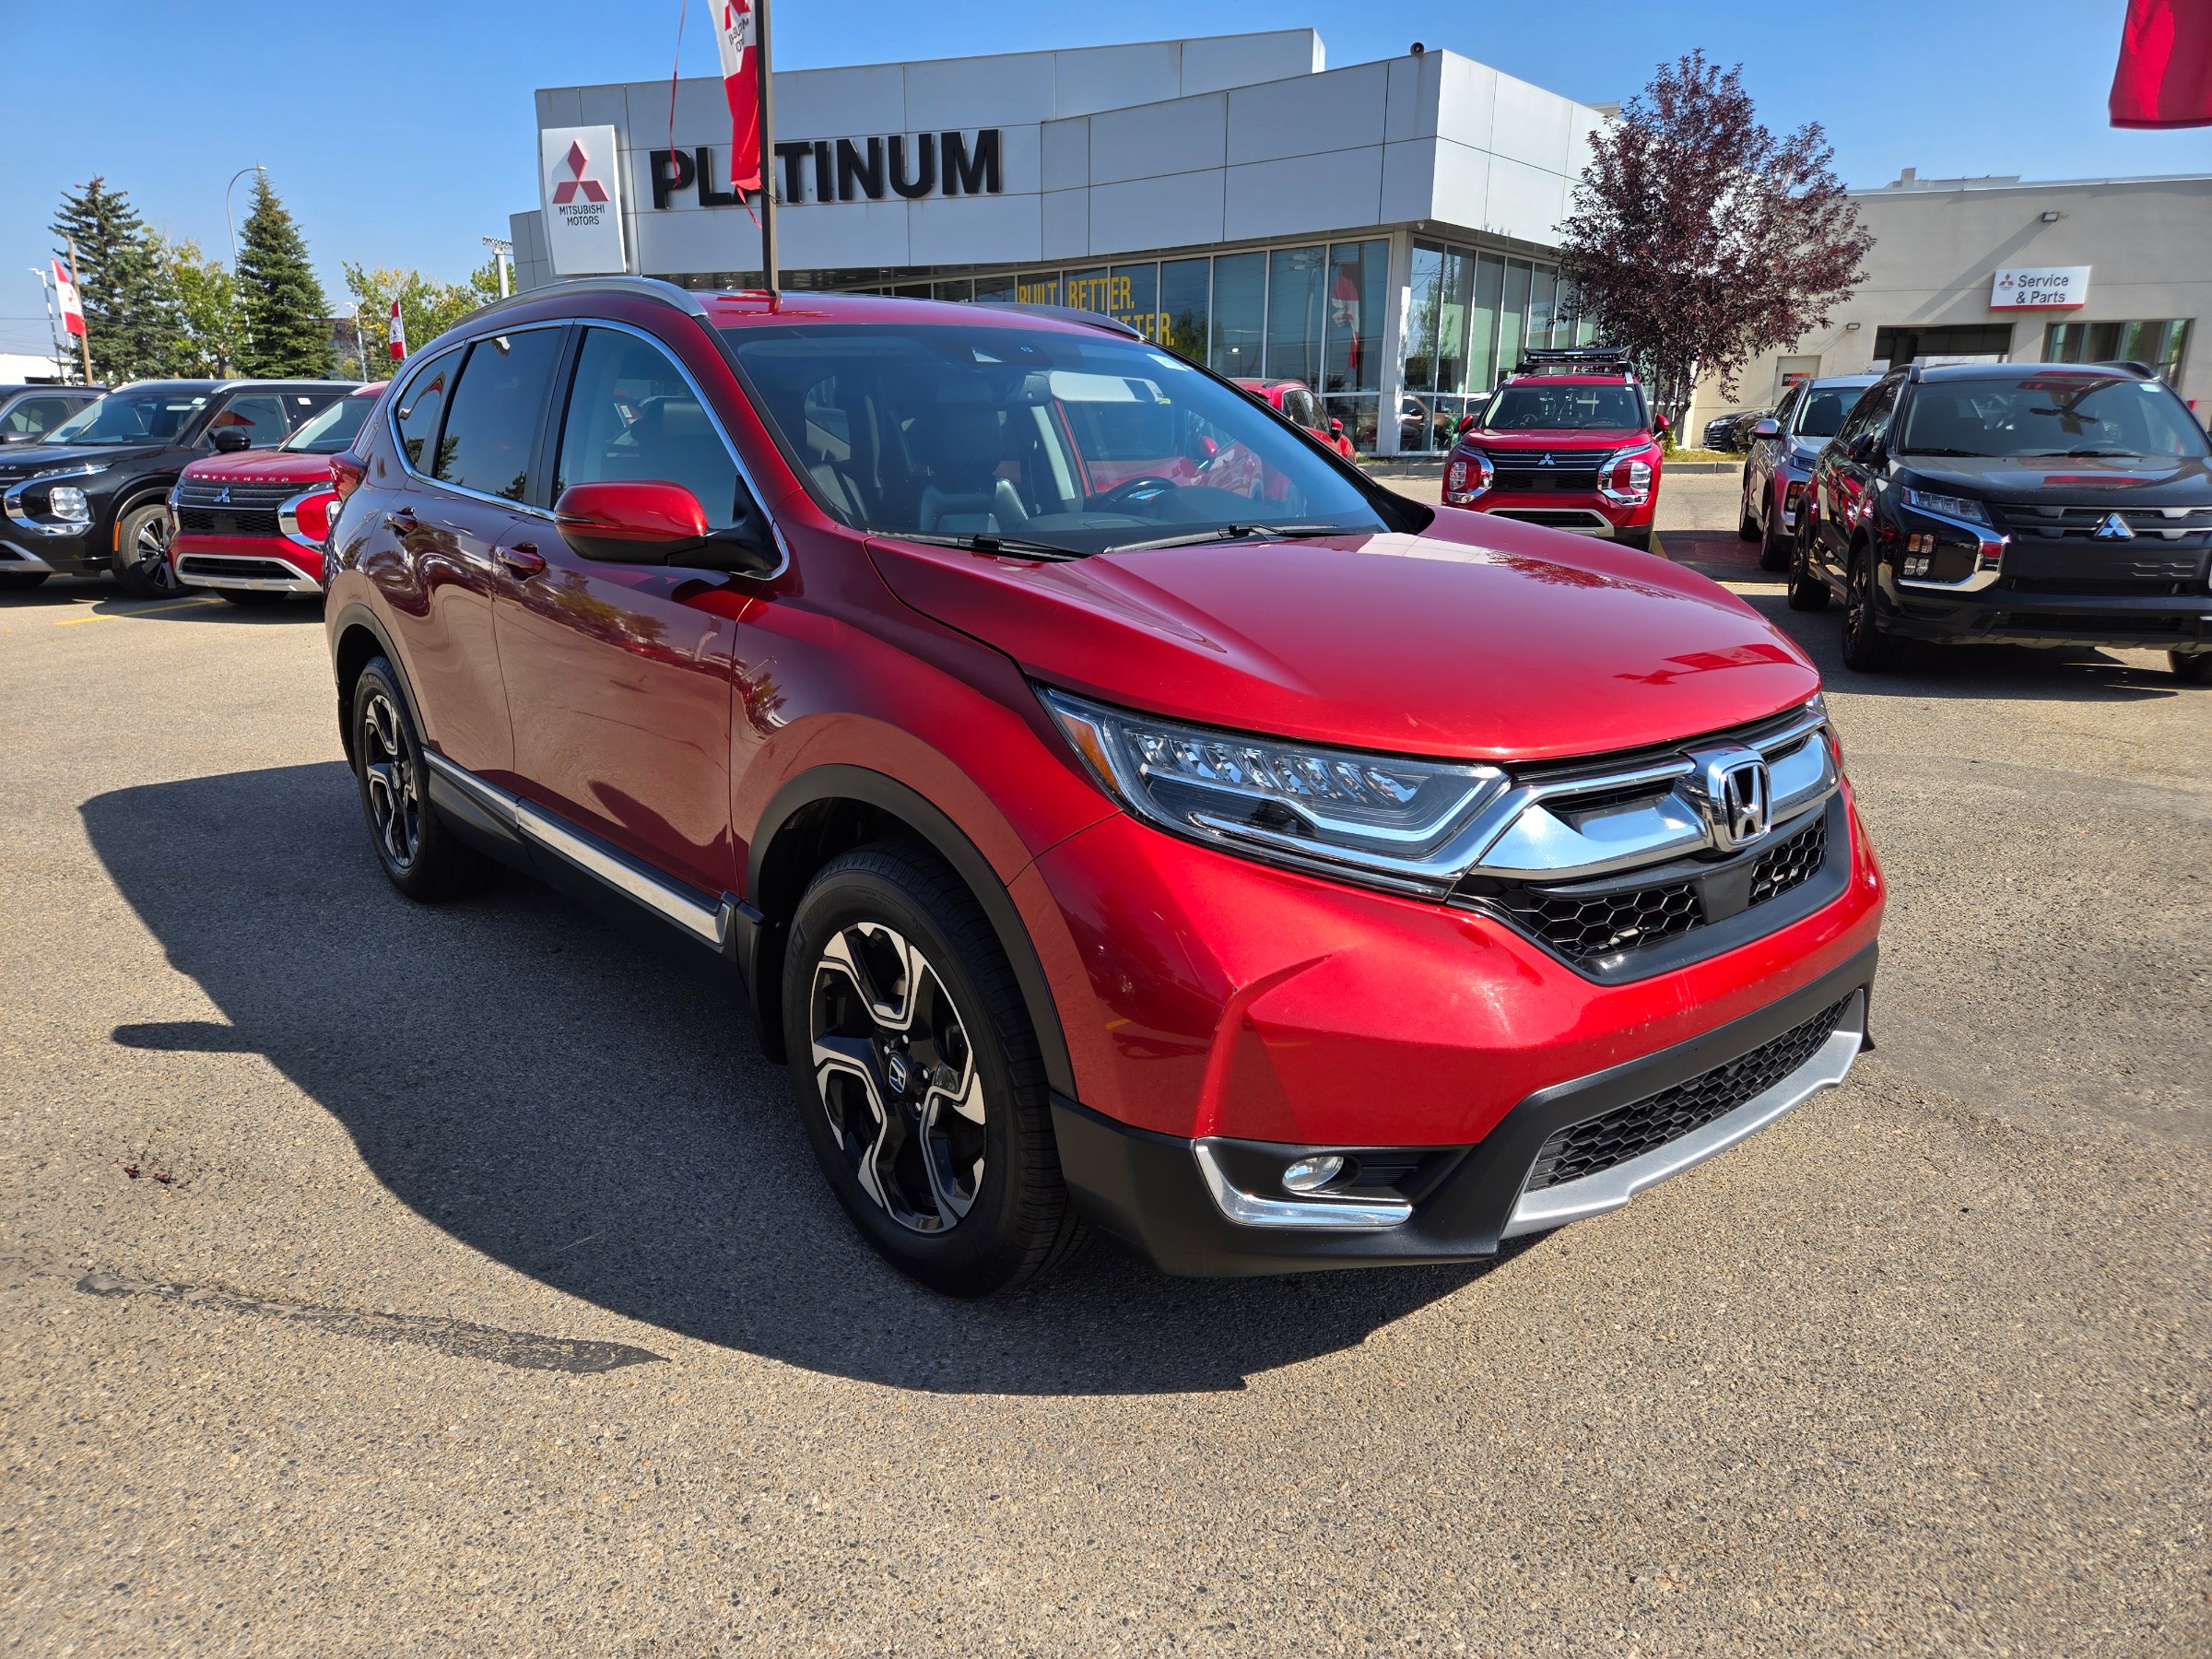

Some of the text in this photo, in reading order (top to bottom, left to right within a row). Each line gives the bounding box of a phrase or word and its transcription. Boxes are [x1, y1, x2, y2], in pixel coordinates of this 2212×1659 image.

[650, 129, 1001, 209] PLTINUM
[559, 204, 606, 216] MITSUBISHI
[567, 215, 600, 227] MOTORS
[2018, 274, 2069, 288] Service
[1068, 276, 1135, 312] BETTER.
[2016, 290, 2065, 304] & Parts
